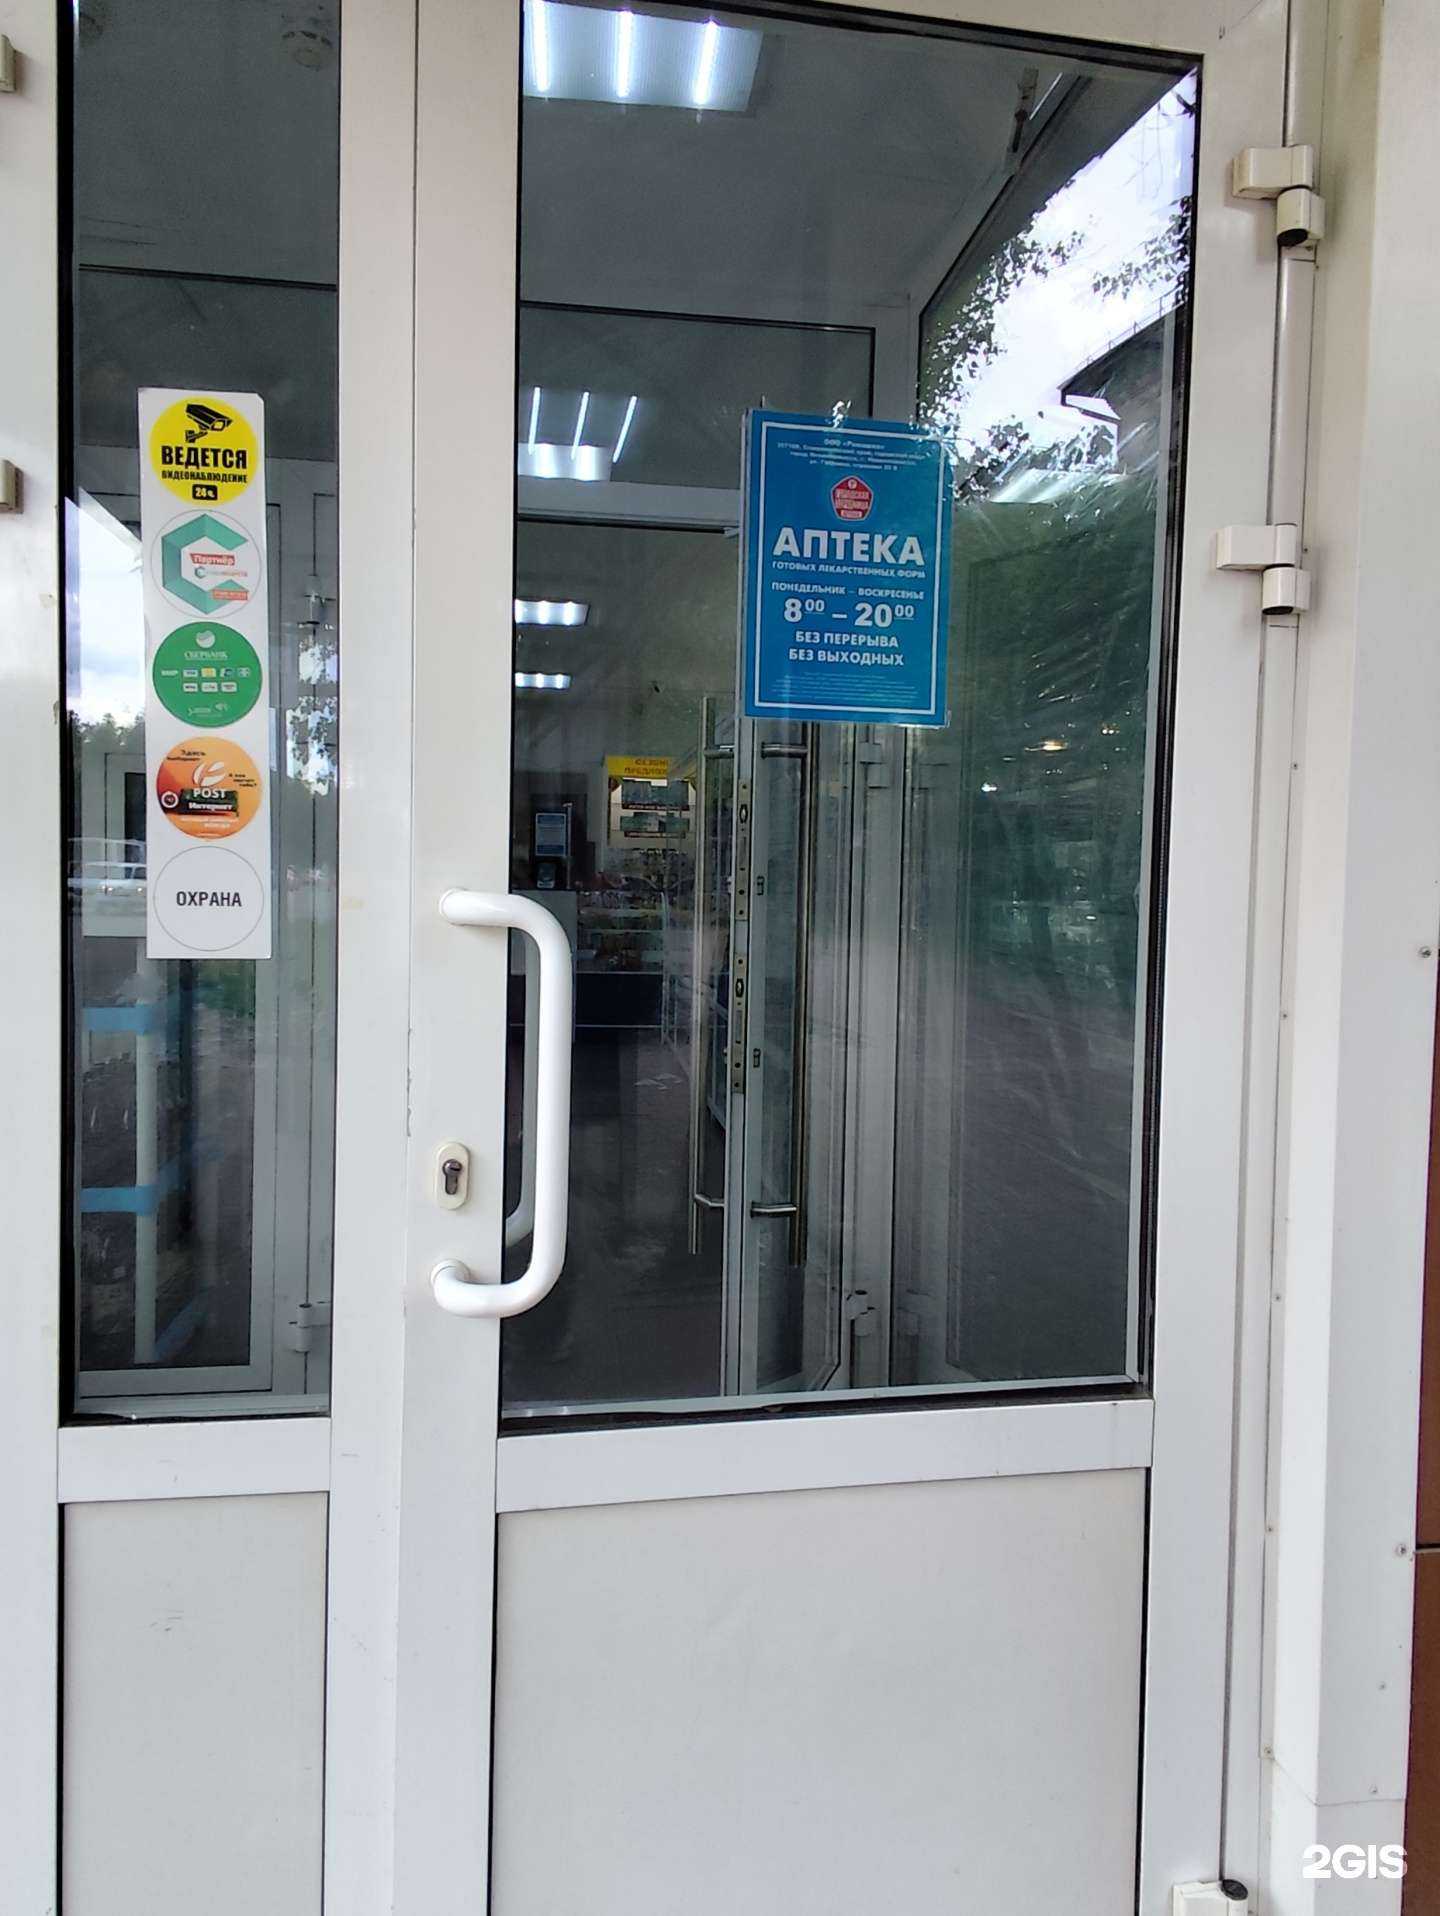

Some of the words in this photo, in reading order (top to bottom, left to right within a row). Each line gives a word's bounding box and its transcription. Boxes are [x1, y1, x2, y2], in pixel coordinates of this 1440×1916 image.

[161, 446, 247, 469] ВЕДЕТСЯ
[162, 470, 247, 483] ВИДЕОНАБЛЮДЕНИЕ
[772, 527, 926, 566] АПТЕКА
[772, 560, 816, 572] ГОТОВЫХ
[818, 563, 895, 578] ЛЕКАРСТВЕННЫХ
[897, 569, 926, 579] ФОРМ
[771, 581, 846, 595] ПОНЕДЕЛЬНИК
[858, 587, 925, 600] ВОСКРЕСЕНЬЕ
[796, 631, 820, 644] БЕЗ
[824, 632, 899, 648] ПЕРЕРЫВА
[789, 648, 814, 661] БЕЗ
[818, 650, 904, 666] ВЫХОДНЫХ
[193, 788, 227, 798] POST
[176, 891, 242, 907] ОХРАНА
